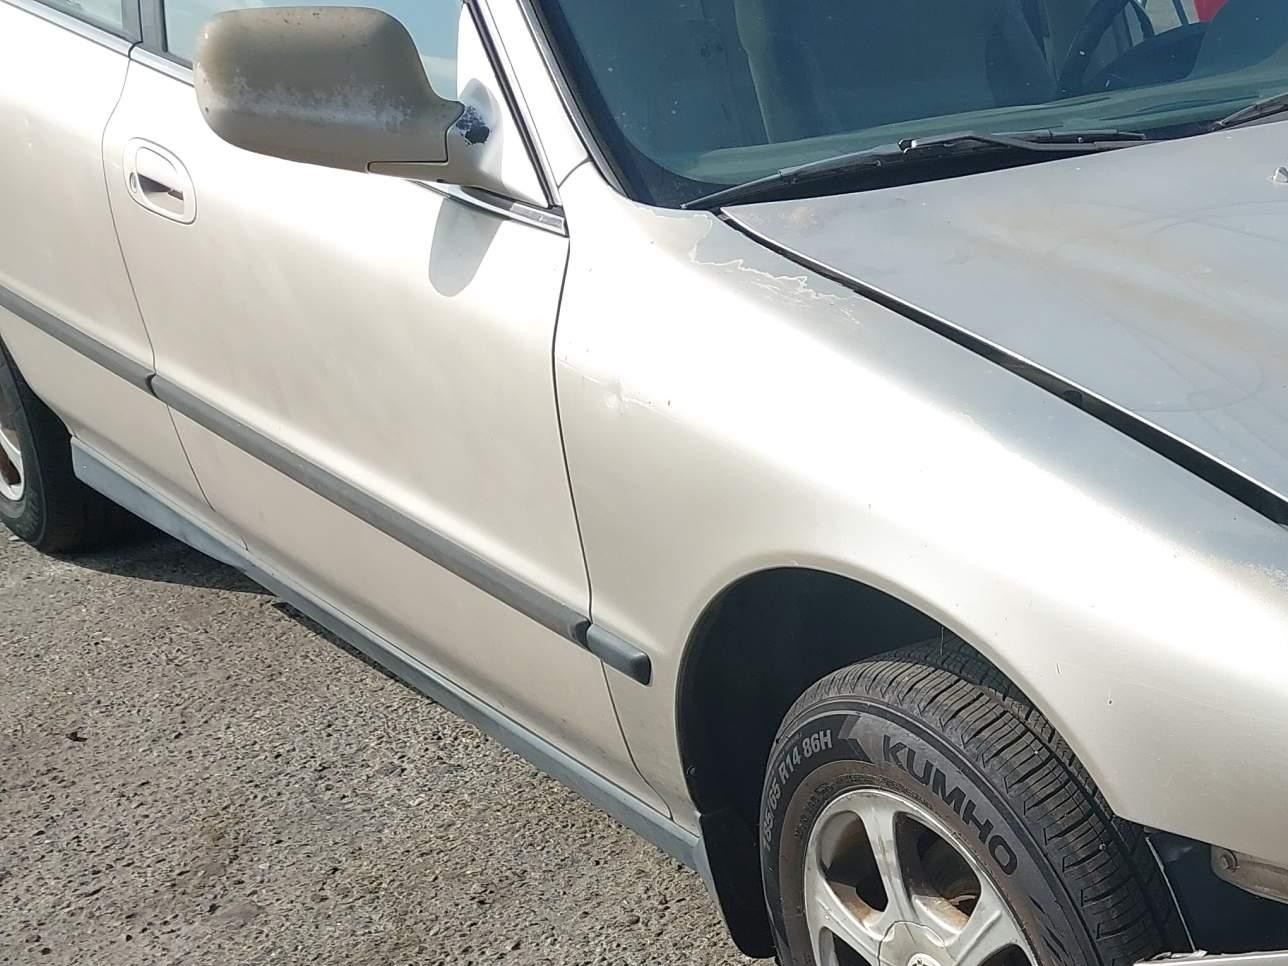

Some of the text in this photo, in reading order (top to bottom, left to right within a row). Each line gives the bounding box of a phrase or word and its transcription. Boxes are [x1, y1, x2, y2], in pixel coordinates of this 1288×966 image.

[779, 745, 801, 784] R14
[802, 729, 833, 758] 86H
[883, 734, 1018, 875] KUMHO
